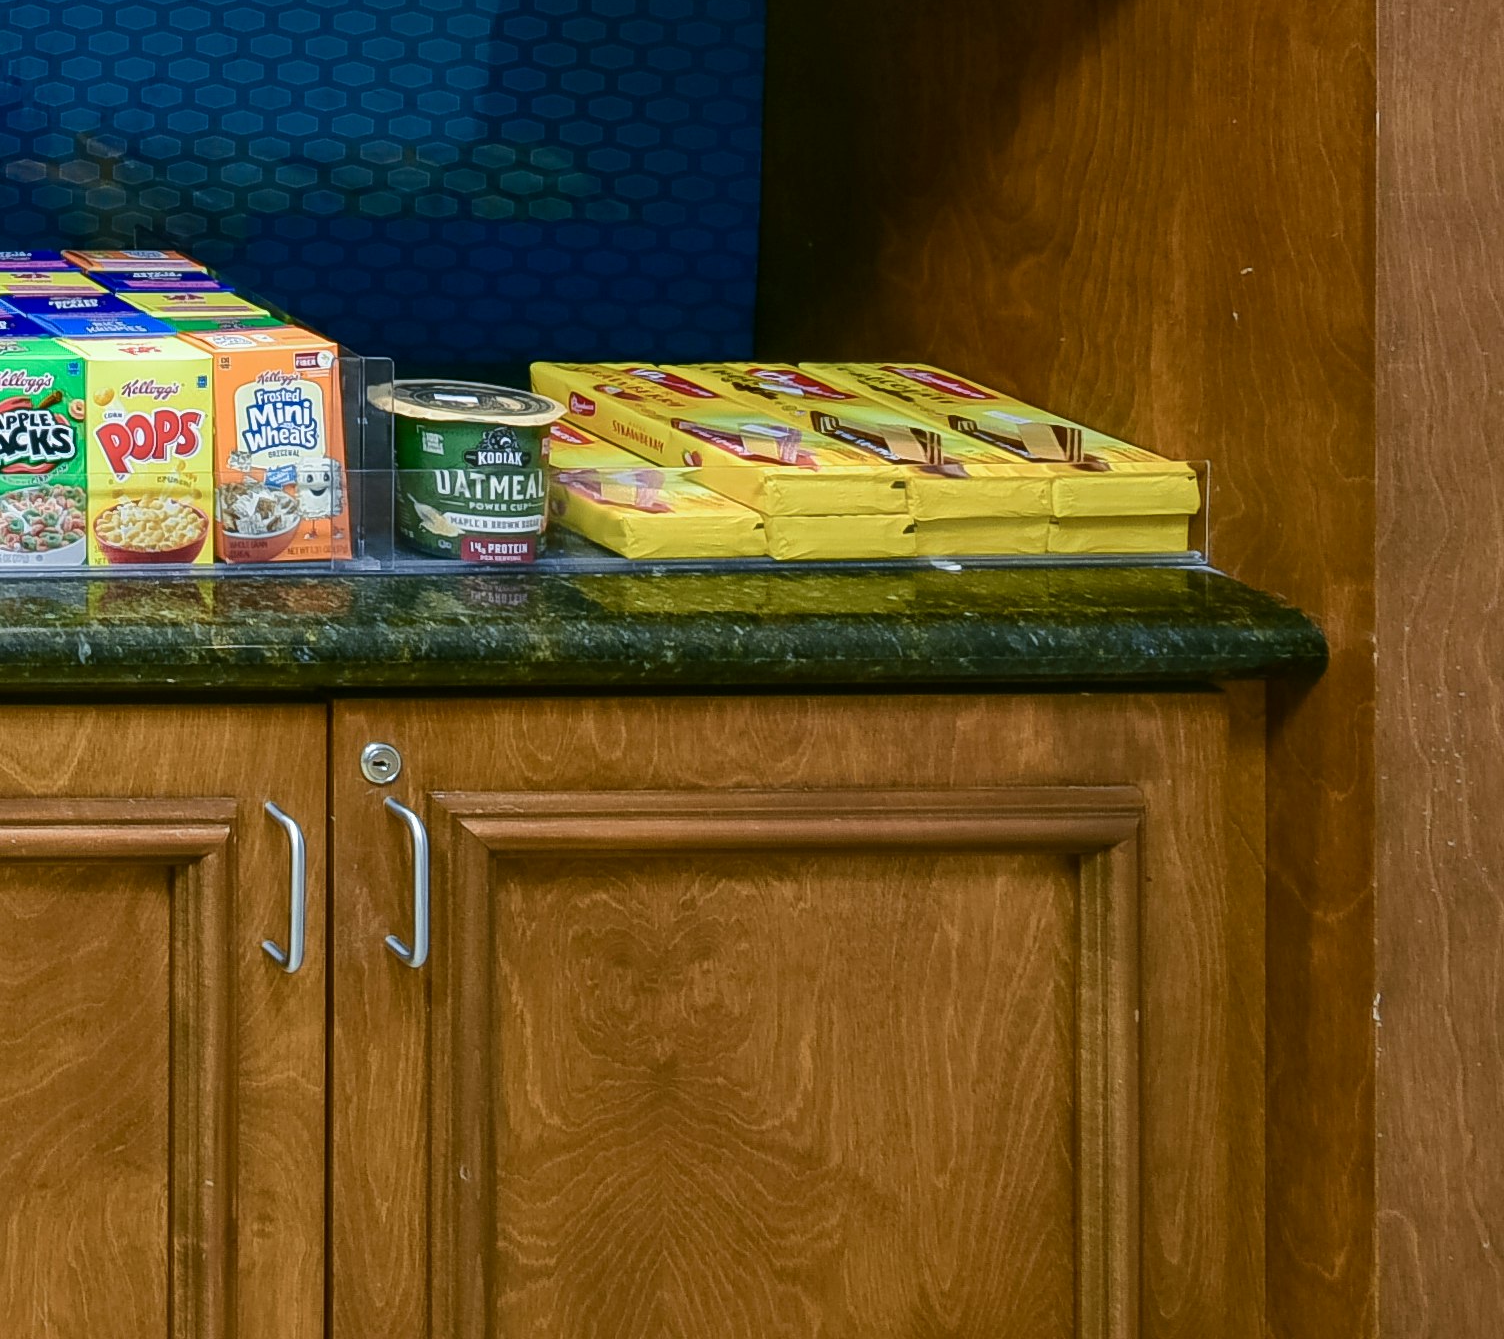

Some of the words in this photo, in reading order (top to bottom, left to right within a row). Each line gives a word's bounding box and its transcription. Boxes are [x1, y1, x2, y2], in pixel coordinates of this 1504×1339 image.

[94, 409, 202, 481] POPS
[477, 452, 523, 466] KODIAK
[469, 502, 507, 511] POWER
[488, 543, 528, 554] PROTEIN
